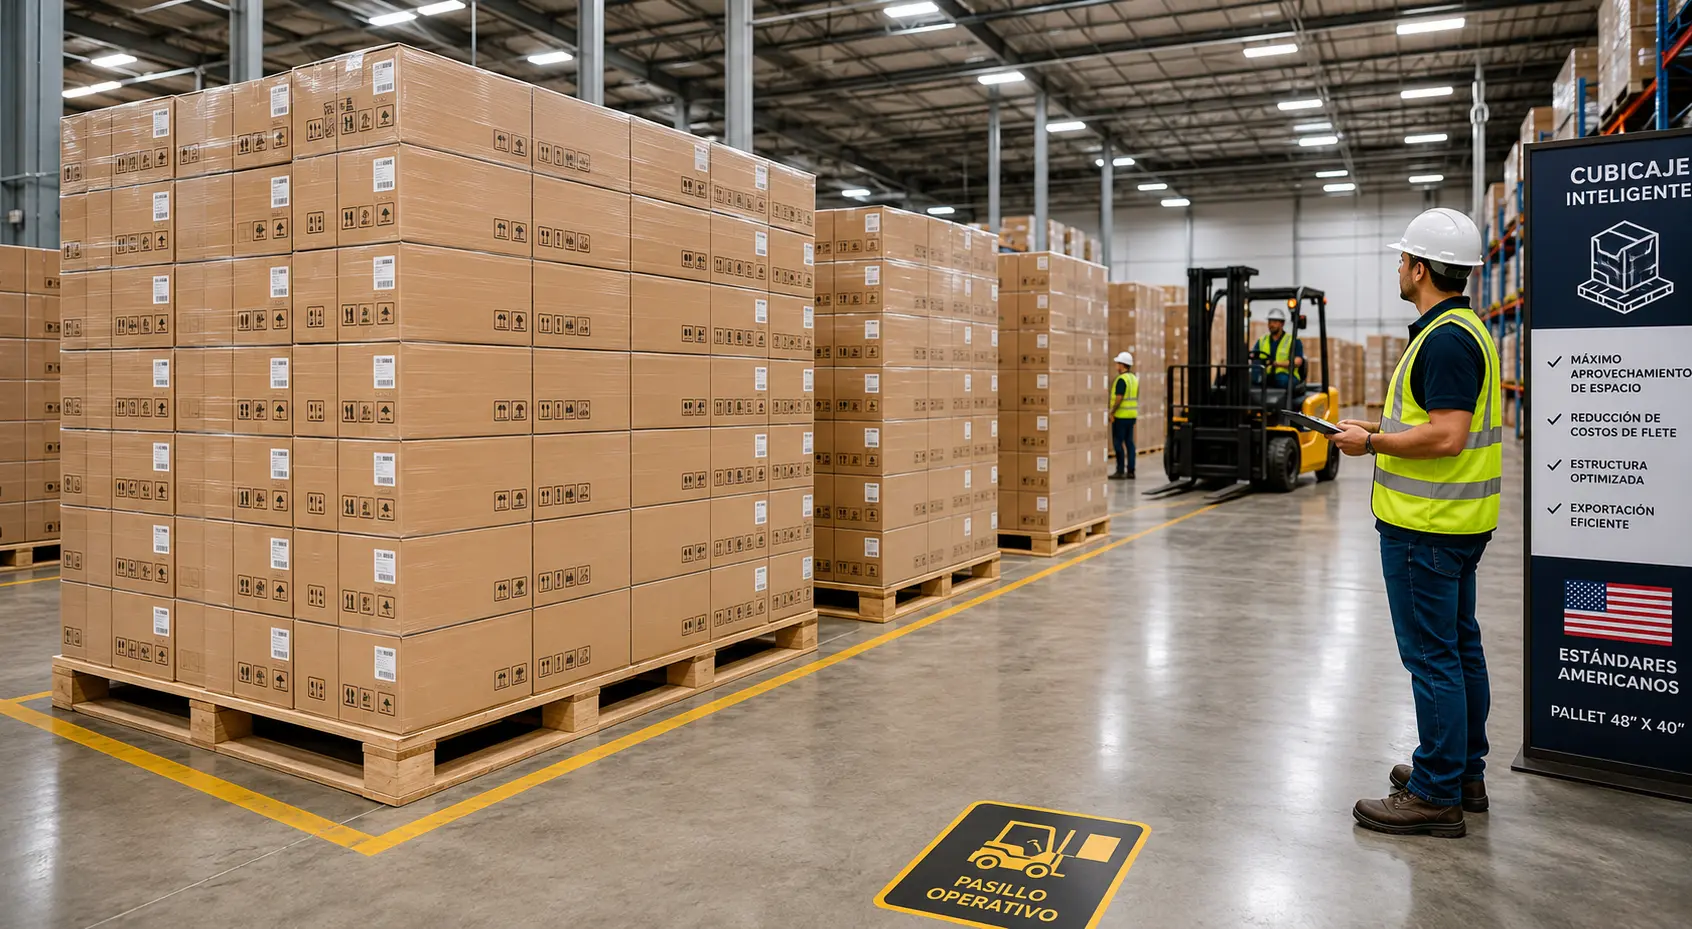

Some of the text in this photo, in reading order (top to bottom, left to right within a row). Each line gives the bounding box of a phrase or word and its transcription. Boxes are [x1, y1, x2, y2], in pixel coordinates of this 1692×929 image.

[1570, 157, 1690, 185] CUBICAJE
[1566, 183, 1692, 206] INTELIGENTE
[1570, 353, 1622, 365] MÁXIMO
[1570, 368, 1692, 379] APROVECHAMIENTO
[1570, 383, 1642, 393] DE ESPACIO
[1570, 411, 1661, 423] REDUCCIÓN DE
[1570, 427, 1677, 438] COSTOS DE FLETE
[1570, 459, 1648, 470] ESTRUCTURA
[1570, 473, 1645, 485] OPTIMIZADA
[1570, 503, 1655, 516] EXPORTACIÓN
[1570, 517, 1630, 530] EFICIENTE
[1559, 647, 1677, 674] ESTÁNDARES
[1558, 667, 1679, 694] AMERICANOS
[1551, 704, 1606, 724] PALLET
[1641, 717, 1652, 731] X
[954, 875, 1047, 902] PASILLO
[926, 888, 1058, 922] OPERATIVO
